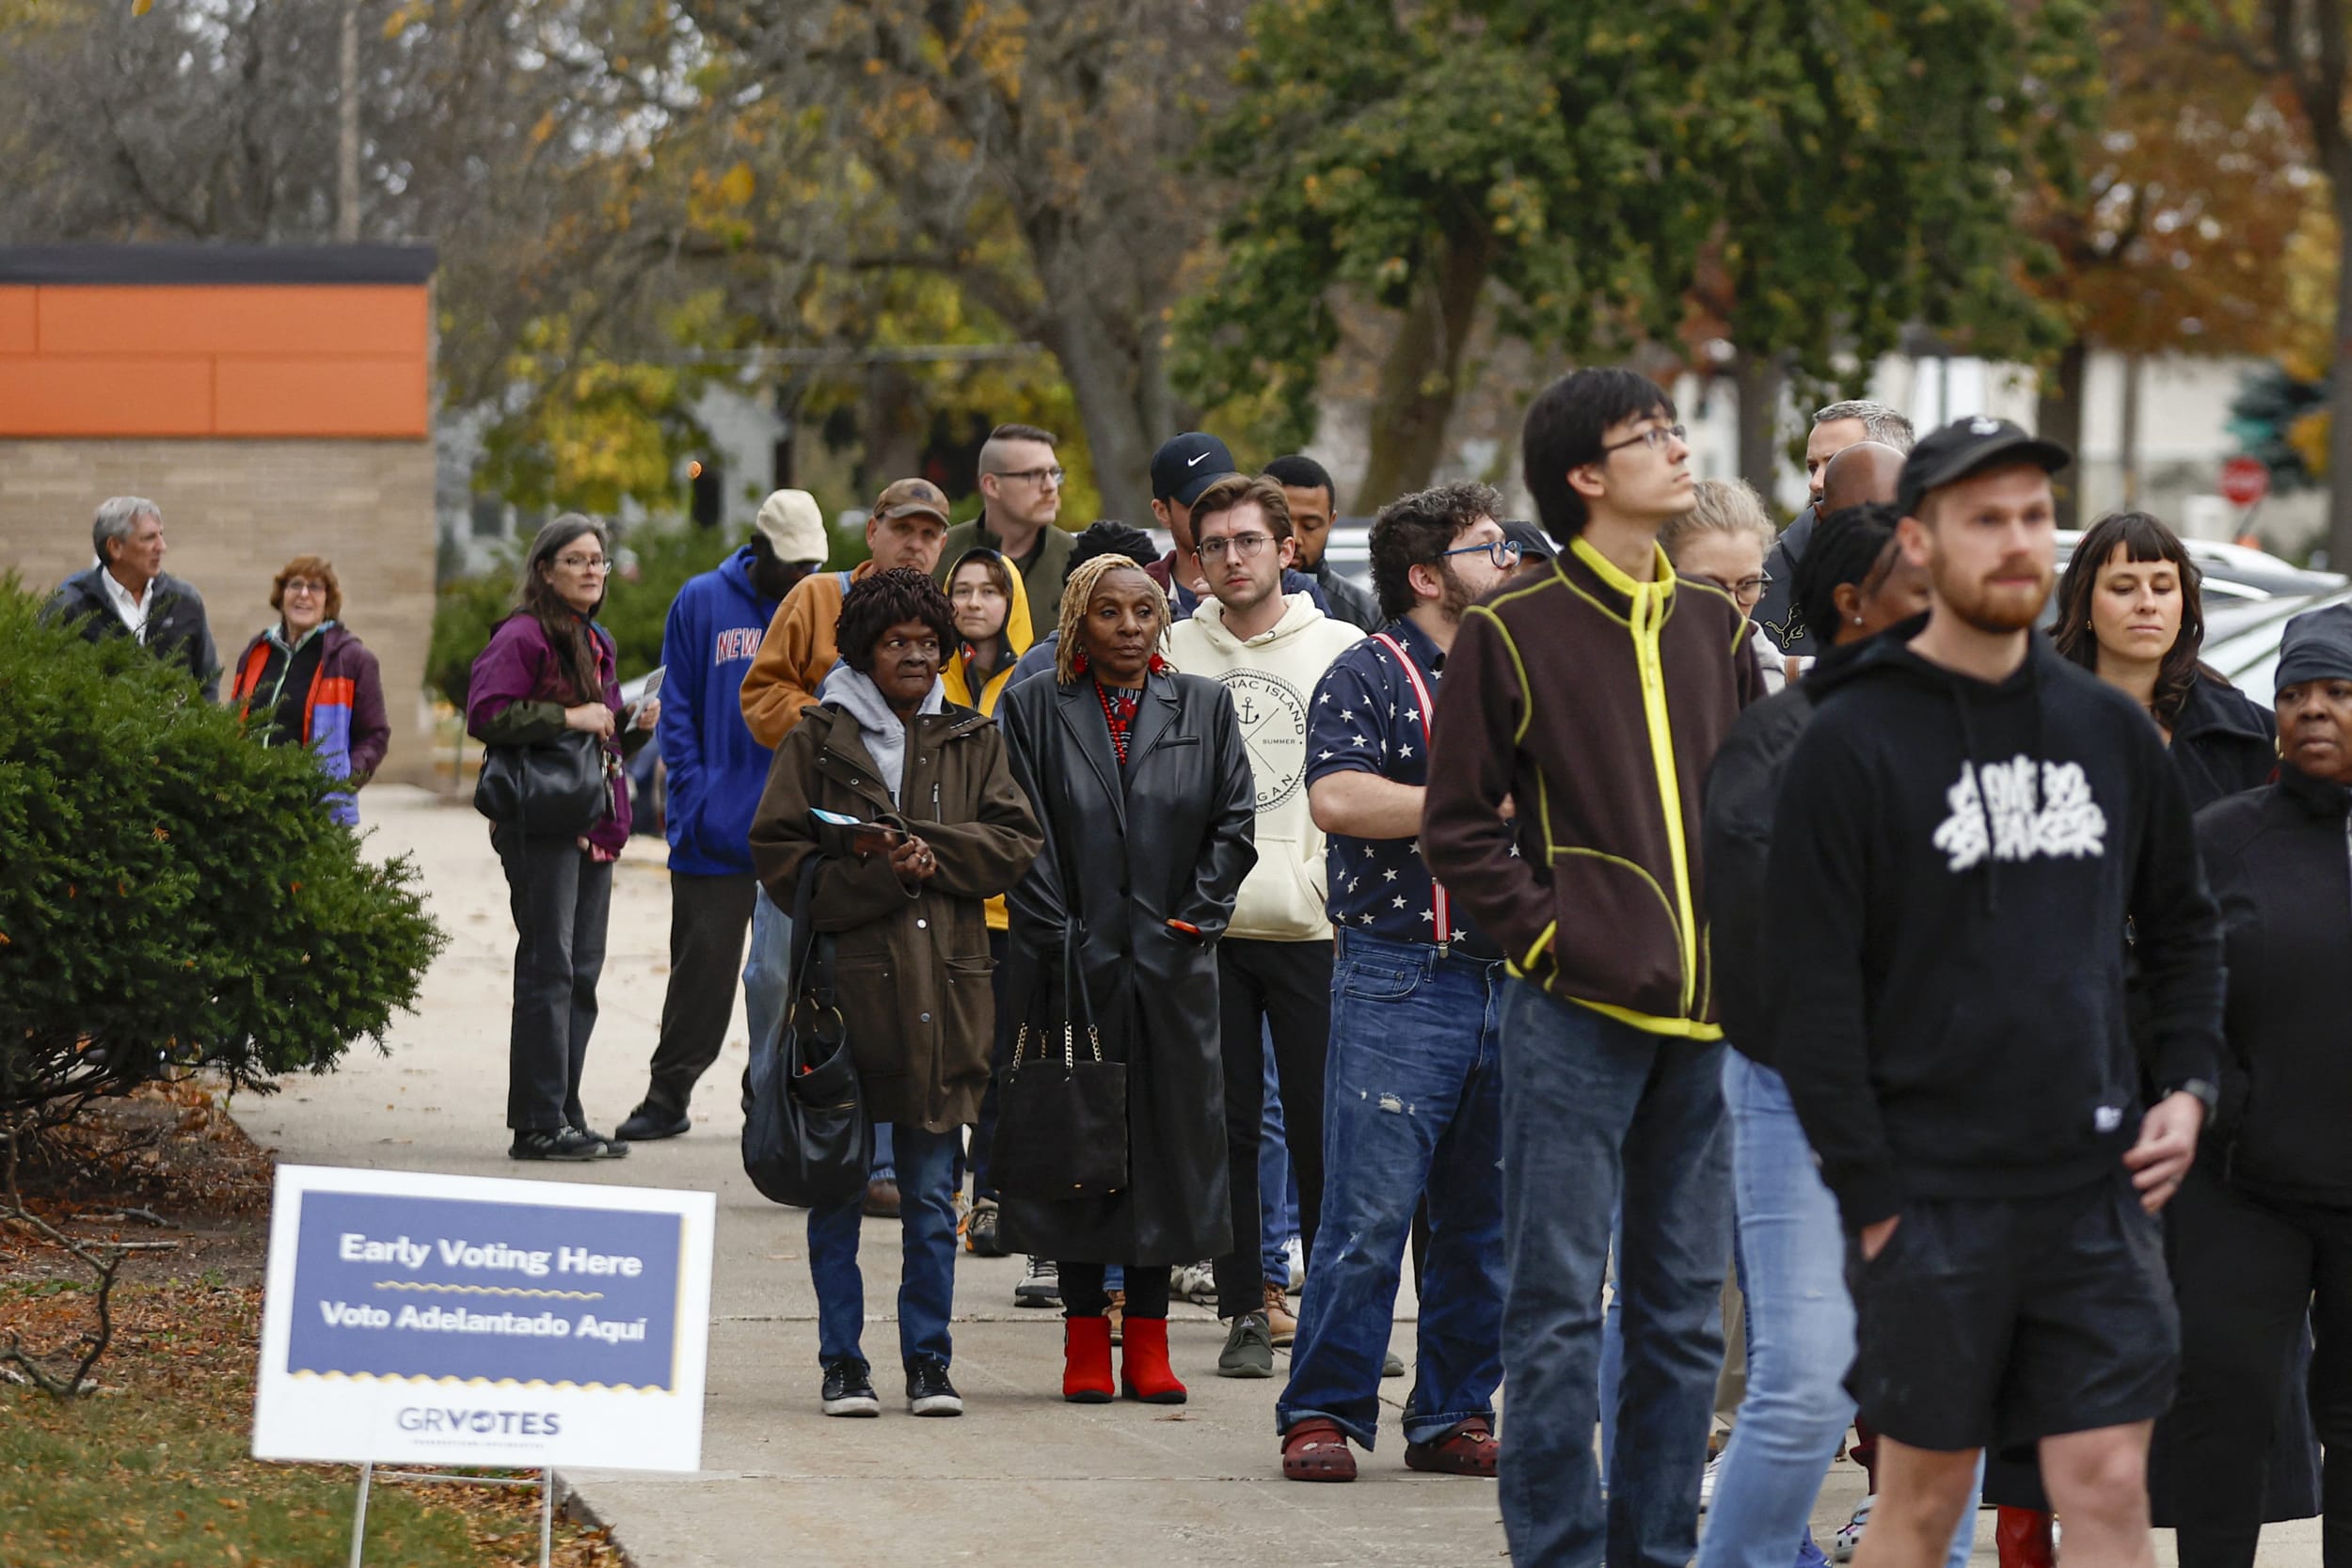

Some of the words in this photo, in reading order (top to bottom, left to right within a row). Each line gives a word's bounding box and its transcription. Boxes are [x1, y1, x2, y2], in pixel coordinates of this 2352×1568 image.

[716, 627, 762, 666] NEW
[1264, 684, 1305, 736] ISLAND
[1262, 737, 1296, 746] SUMMER
[339, 1232, 432, 1269] Early
[437, 1238, 553, 1276] Voting
[556, 1245, 644, 1276] Here
[320, 1300, 391, 1328] Voto
[394, 1304, 571, 1338] Adelantado
[574, 1314, 648, 1344] Aquí
